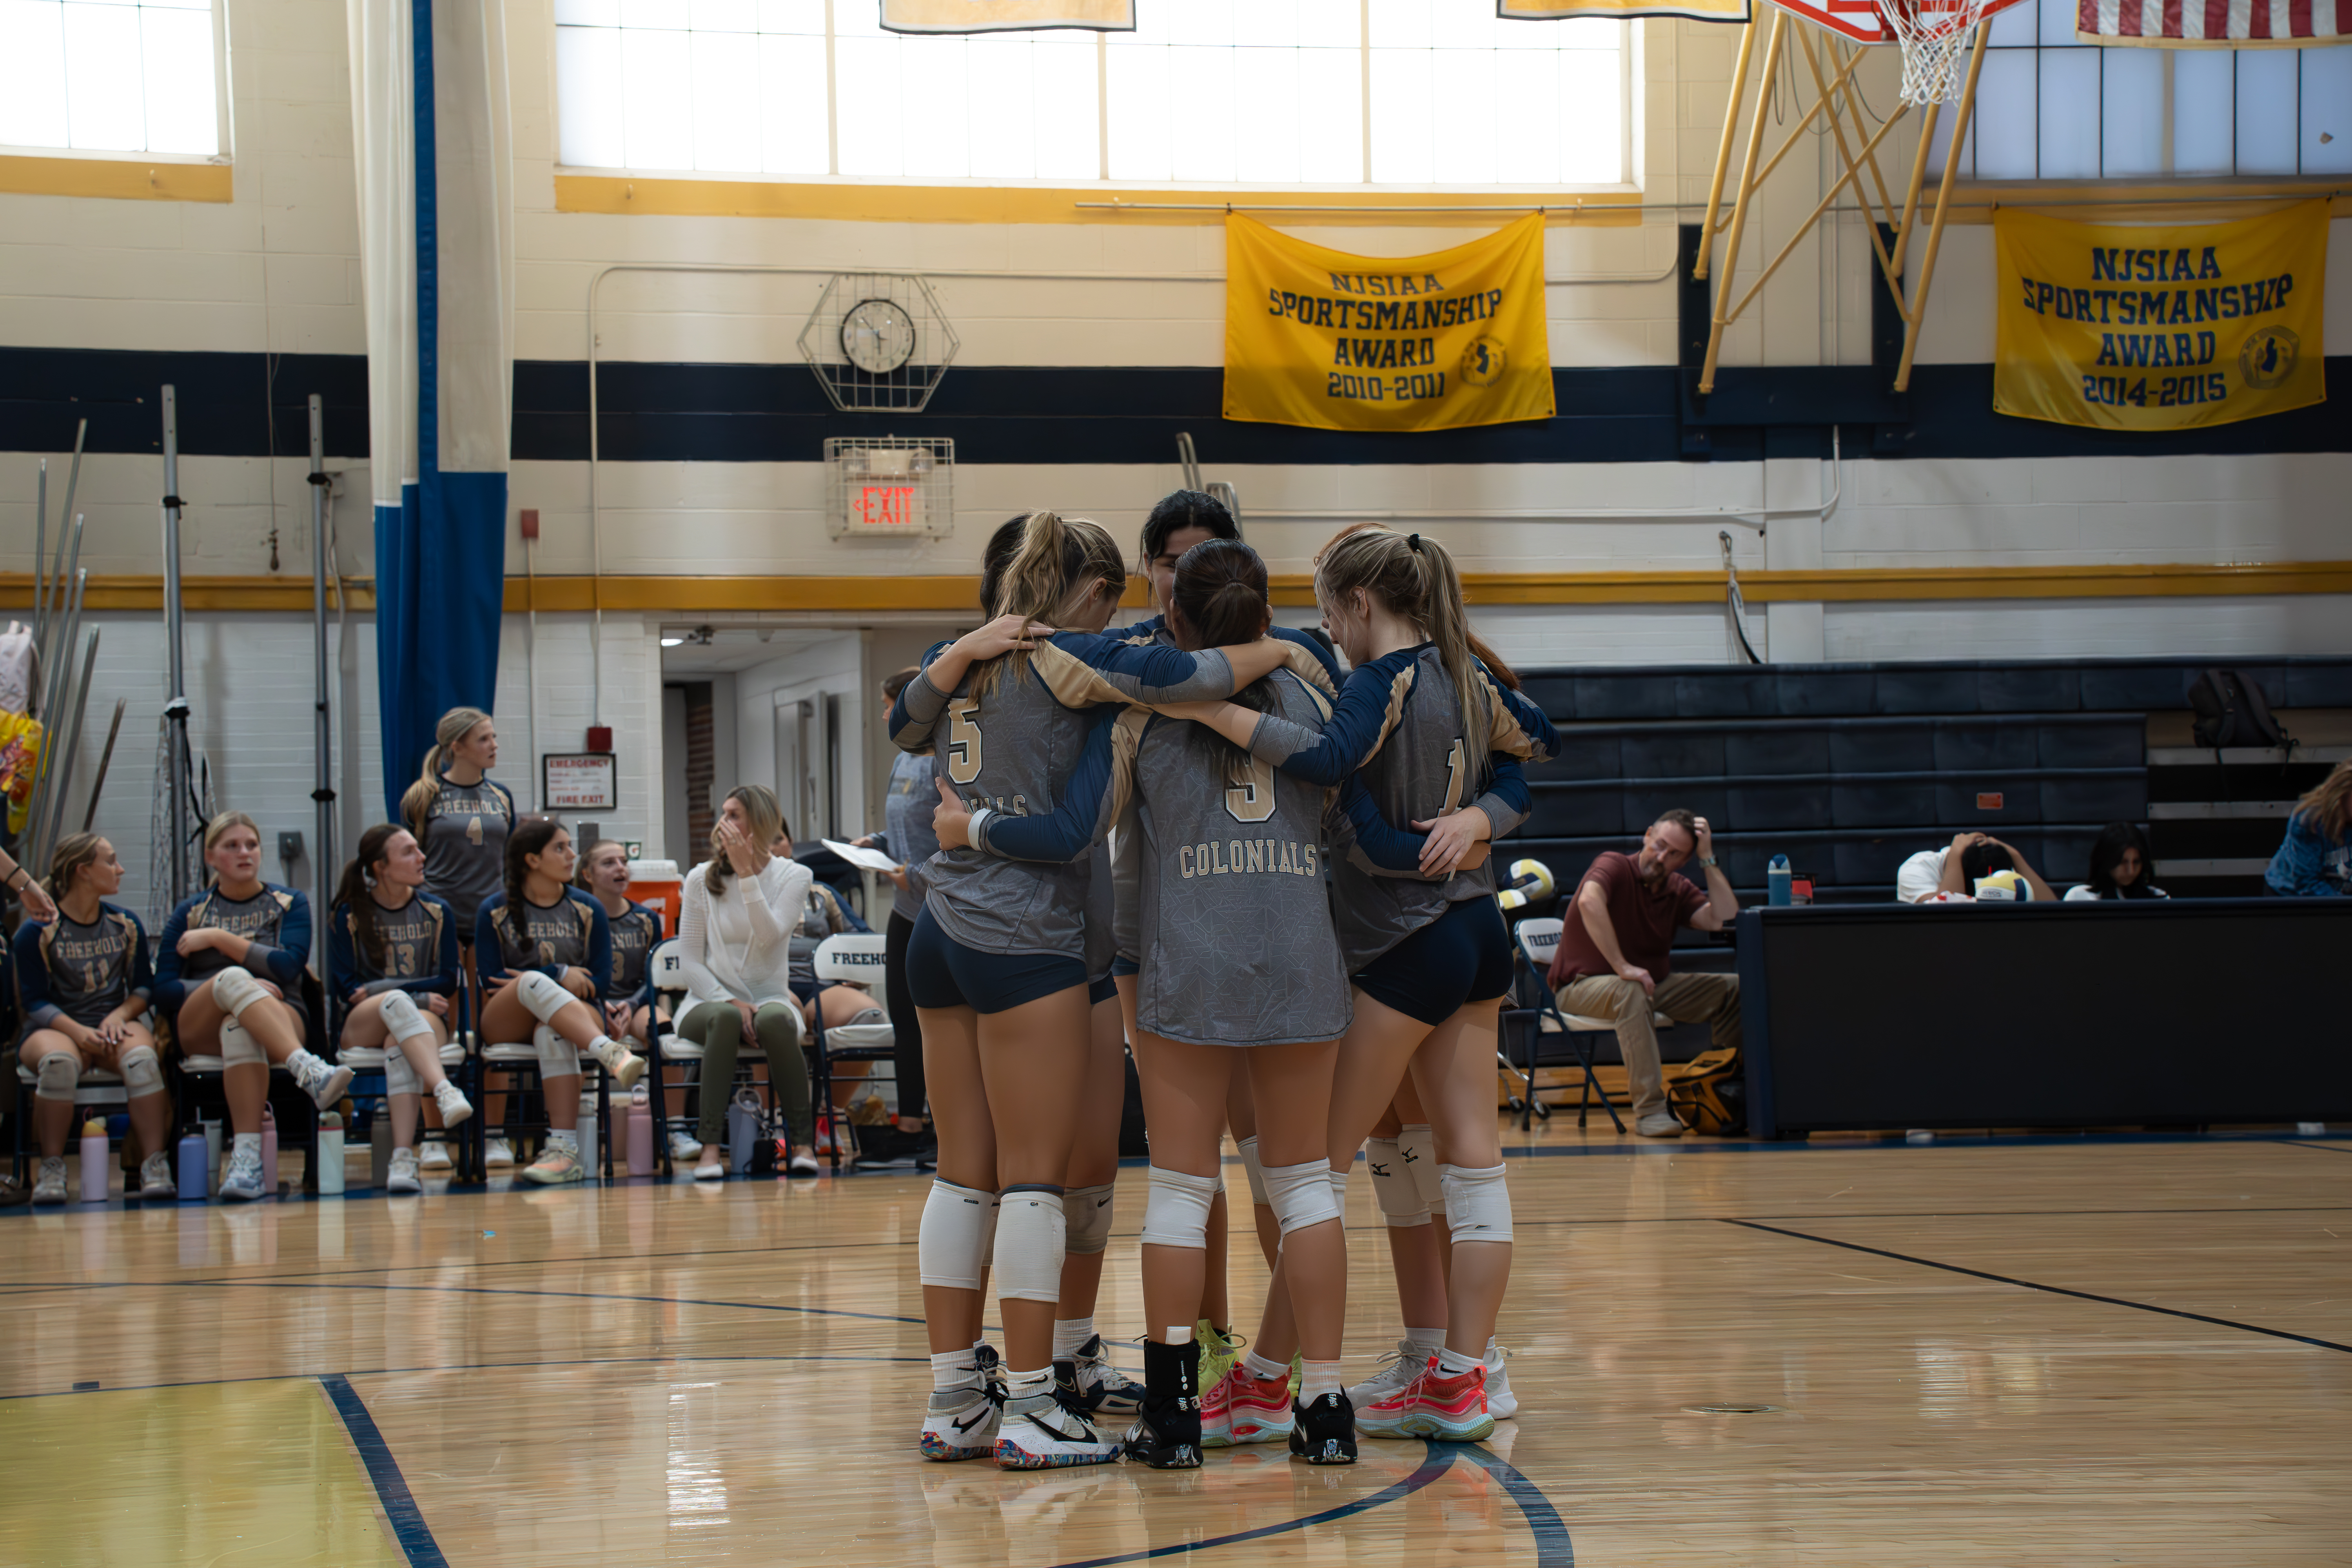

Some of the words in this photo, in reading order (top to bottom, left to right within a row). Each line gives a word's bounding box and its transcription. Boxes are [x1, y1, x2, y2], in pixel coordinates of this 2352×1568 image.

[2092, 247, 2222, 281] NJSIAA
[1328, 272, 1444, 296] NJSIAA
[2022, 273, 2293, 325] SPORTSMANSHIP
[1269, 287, 1502, 330] SPORTSMANSHIP
[1334, 338, 1434, 368] AWARD
[2096, 331, 2216, 367] AWARD
[1327, 372, 1445, 401] 2010-2011
[2082, 372, 2227, 407] 2014-2015
[863, 487, 914, 524] EXIT
[947, 697, 983, 784] 5
[550, 759, 609, 768] EMERGENCY
[556, 795, 579, 804] FIRE
[581, 794, 605, 804] EXIT
[465, 816, 484, 846] 4
[1179, 839, 1317, 879] COLONIALS
[384, 943, 416, 976] 13
